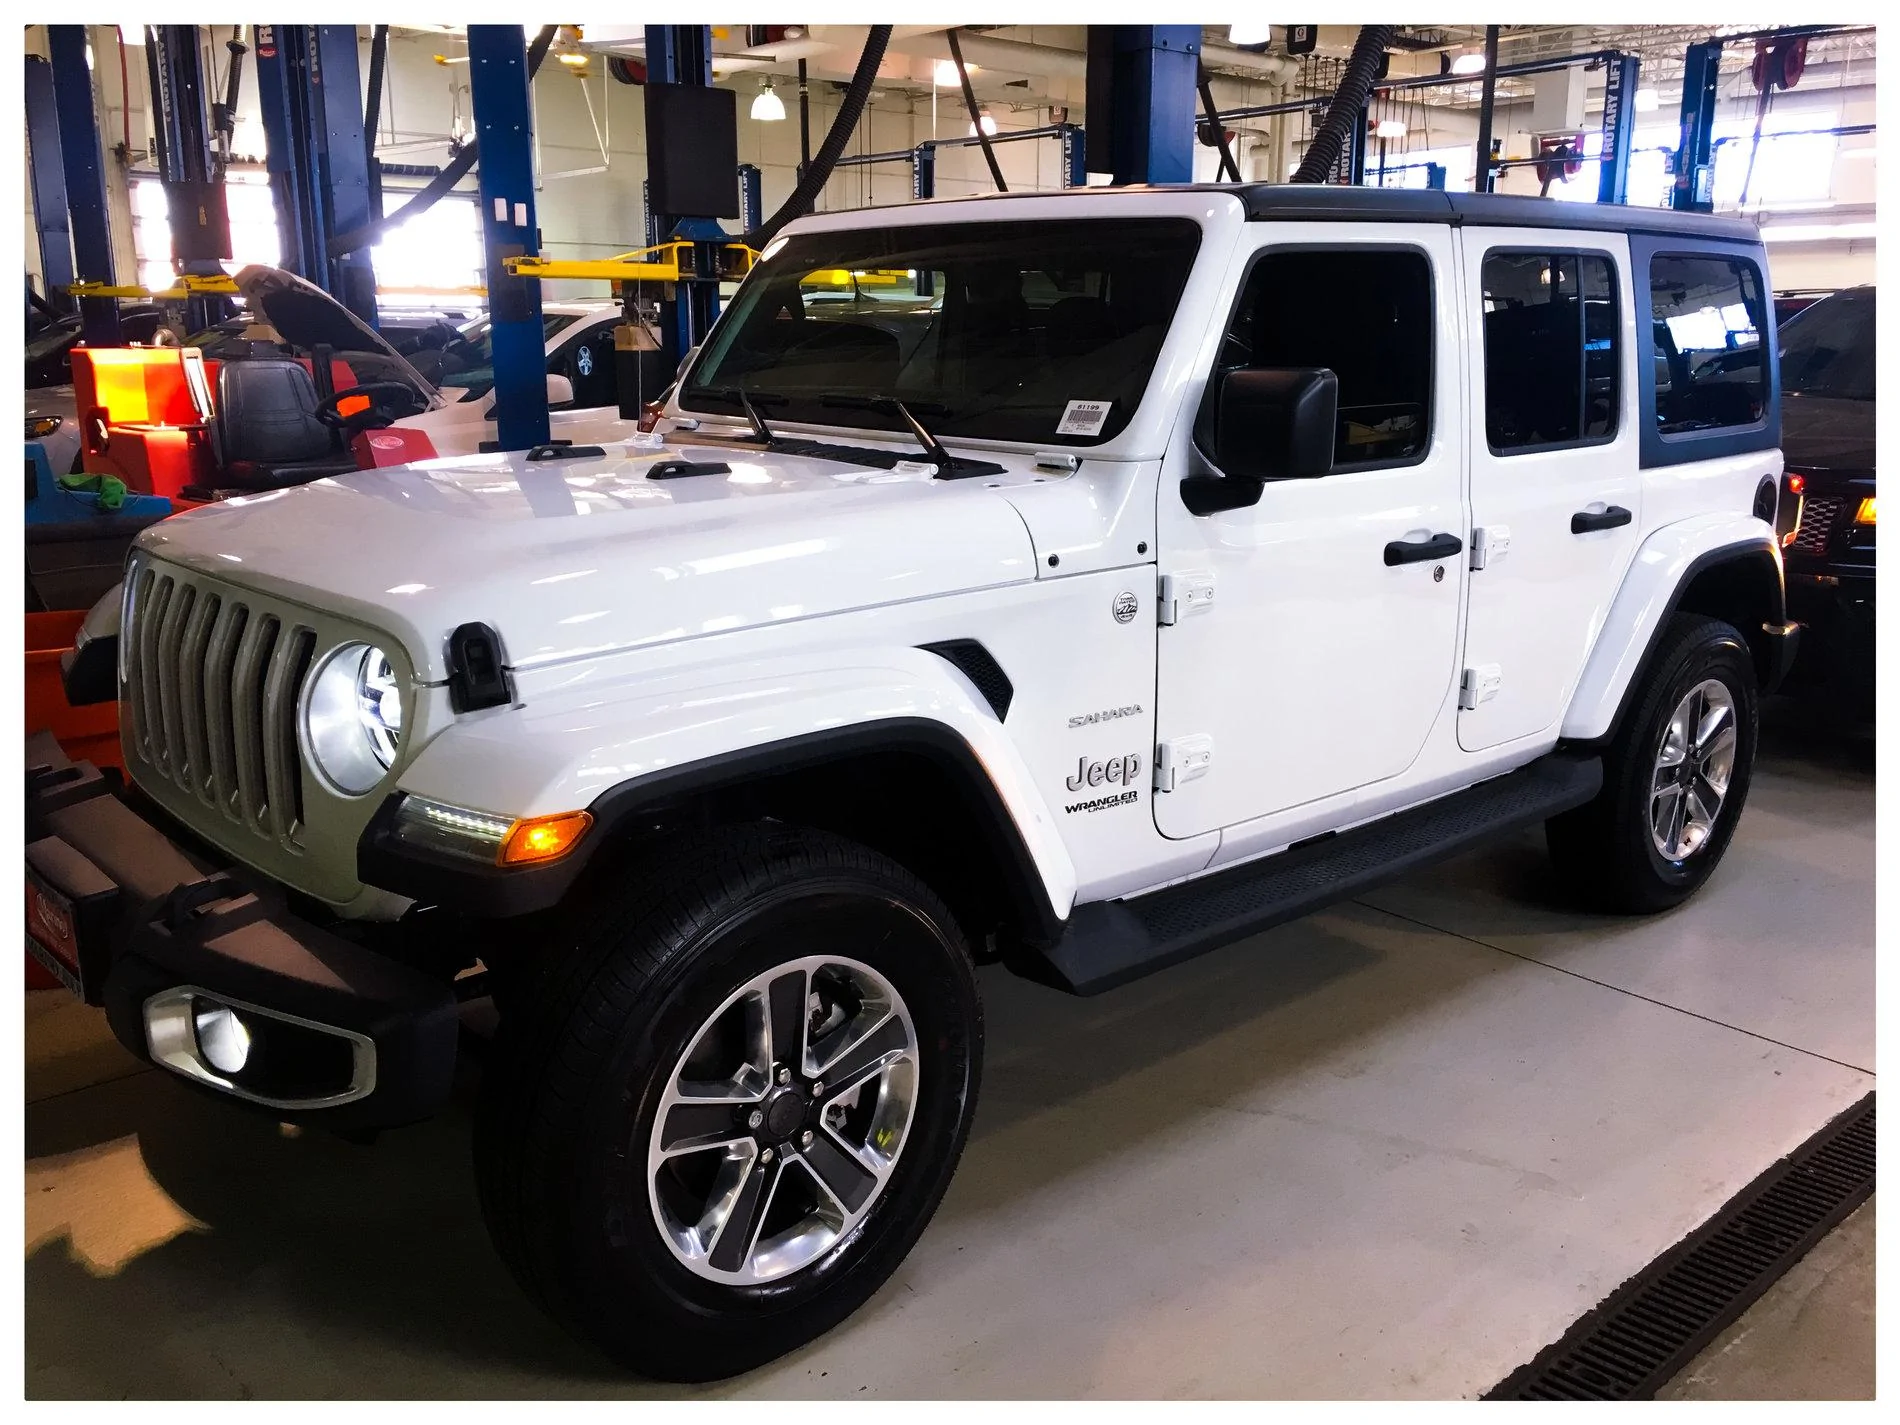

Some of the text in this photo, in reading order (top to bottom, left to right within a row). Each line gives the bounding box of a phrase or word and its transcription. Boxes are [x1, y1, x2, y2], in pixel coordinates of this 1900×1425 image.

[1604, 59, 1622, 153] ROTARY LIFT
[1064, 157, 1072, 190] TARY
[1068, 704, 1143, 729] SAHARA
[1066, 754, 1142, 792] Jeep
[1065, 790, 1138, 814] WRANGLER
[1088, 798, 1138, 813] UNLIMITED
